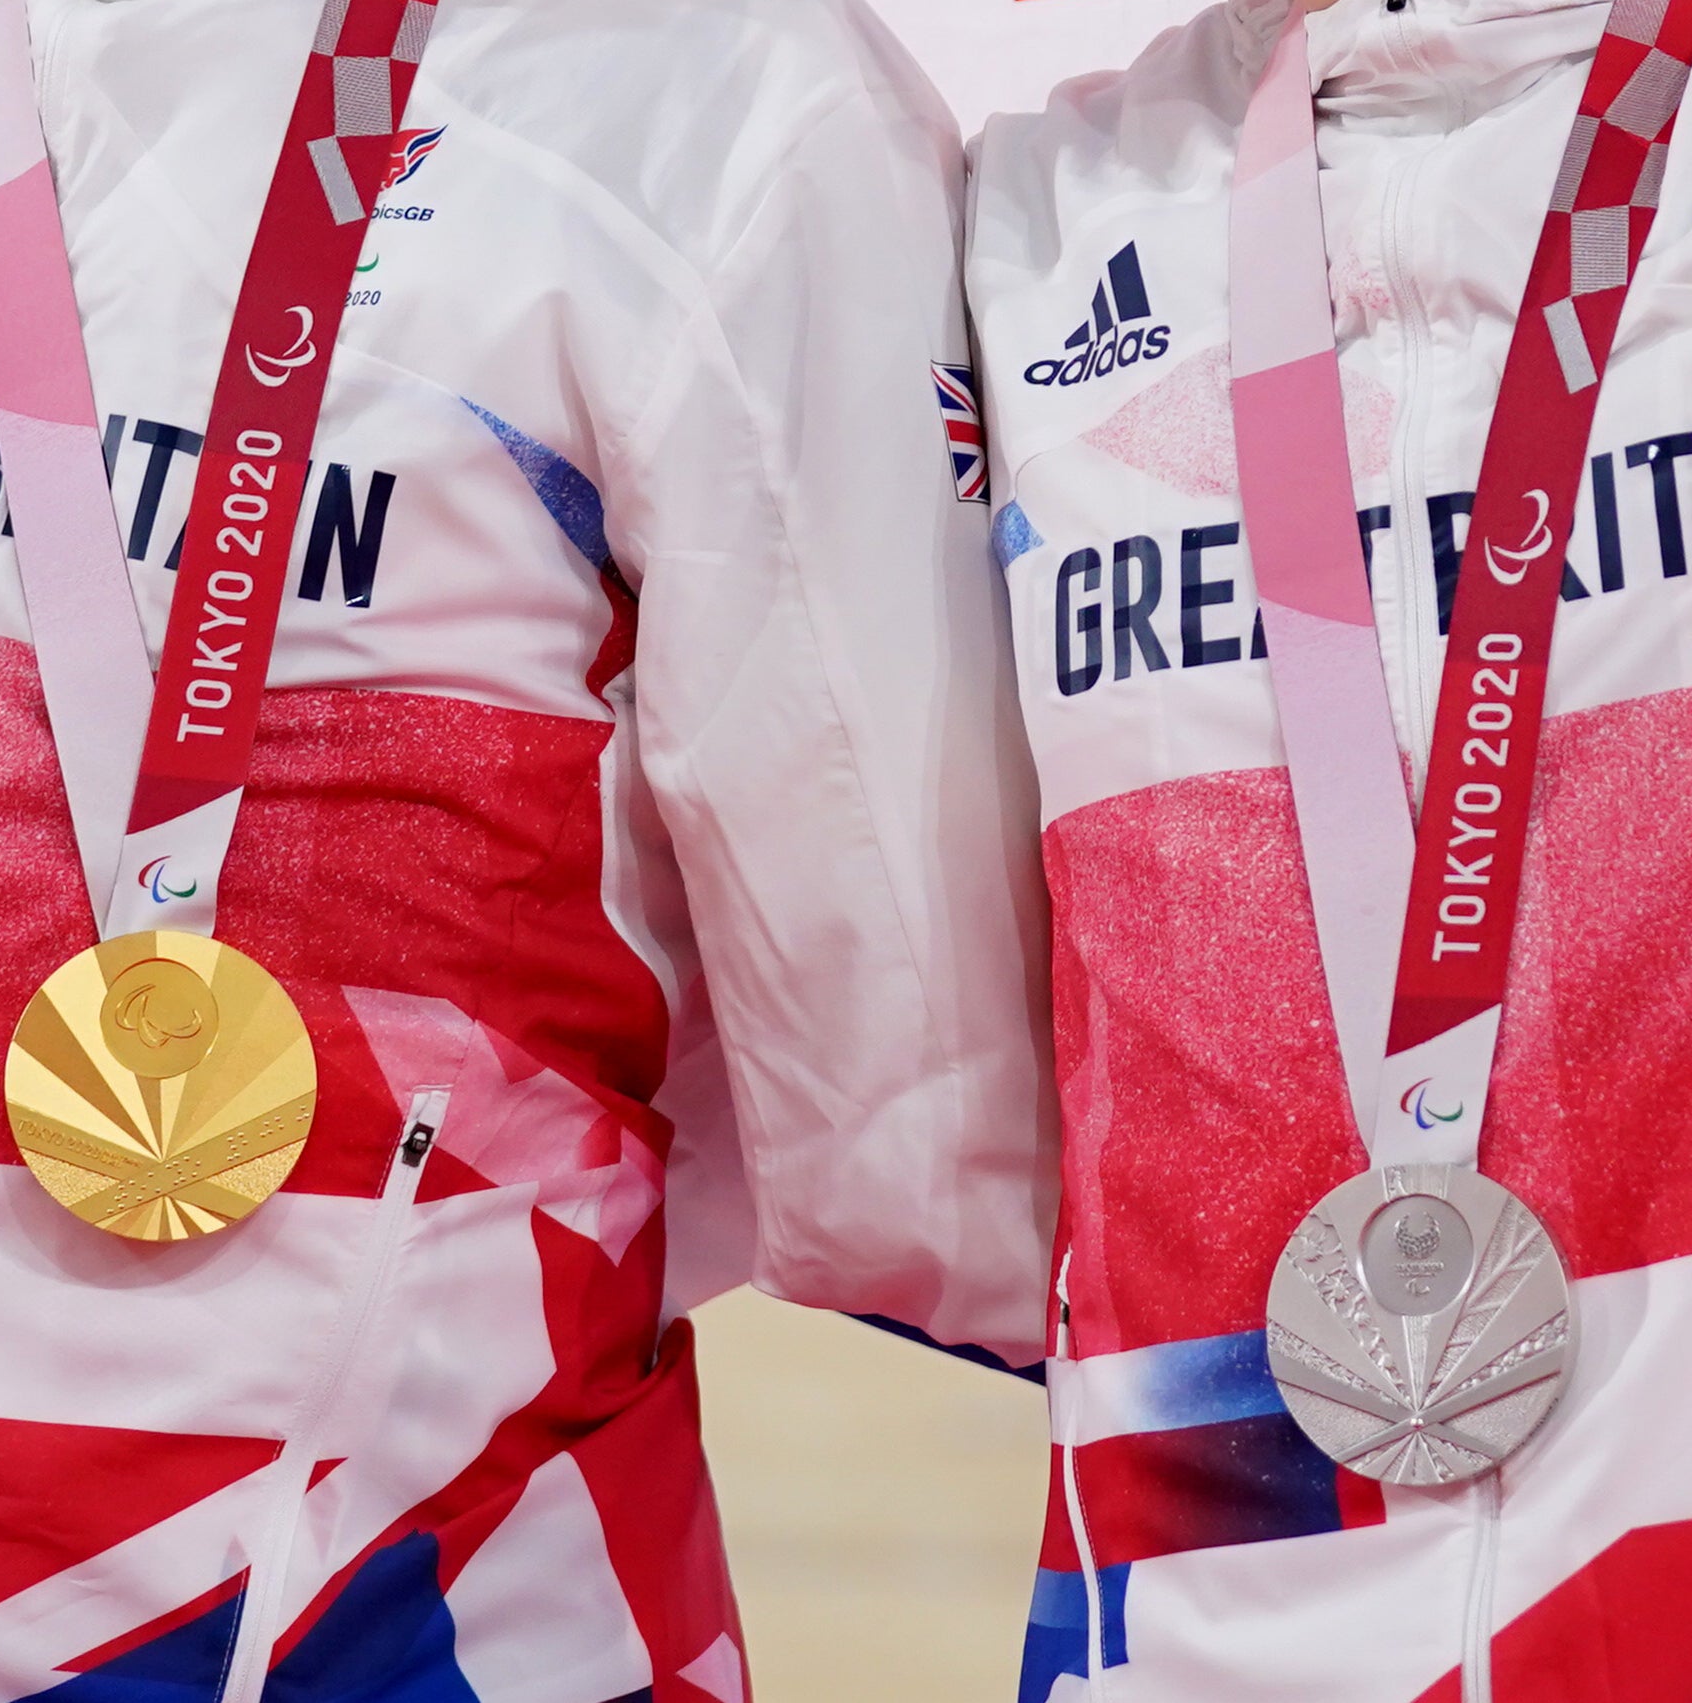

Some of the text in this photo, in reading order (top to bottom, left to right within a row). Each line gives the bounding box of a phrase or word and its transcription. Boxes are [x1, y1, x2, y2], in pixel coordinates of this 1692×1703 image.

[1023, 324, 1171, 387] adidas
[175, 428, 283, 743] TOKYO 2020
[1431, 632, 1524, 963] TOKYO 2020
